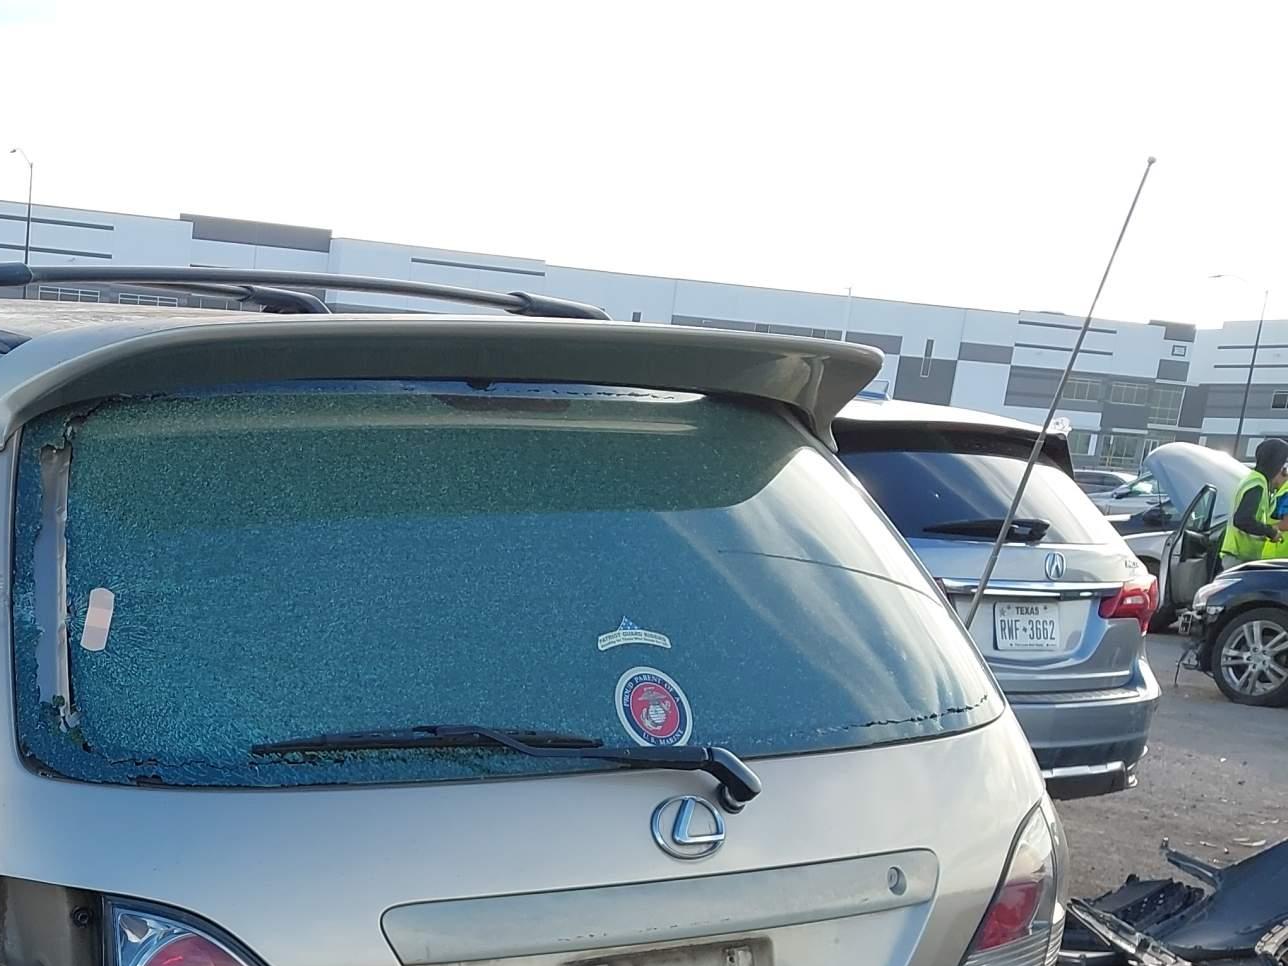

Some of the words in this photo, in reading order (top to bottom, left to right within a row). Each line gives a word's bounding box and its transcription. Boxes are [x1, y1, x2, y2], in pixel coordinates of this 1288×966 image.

[1015, 606, 1040, 616] TEXAS
[623, 682, 634, 707] PROUD
[634, 674, 662, 684] PARENT
[664, 683, 674, 693] OF
